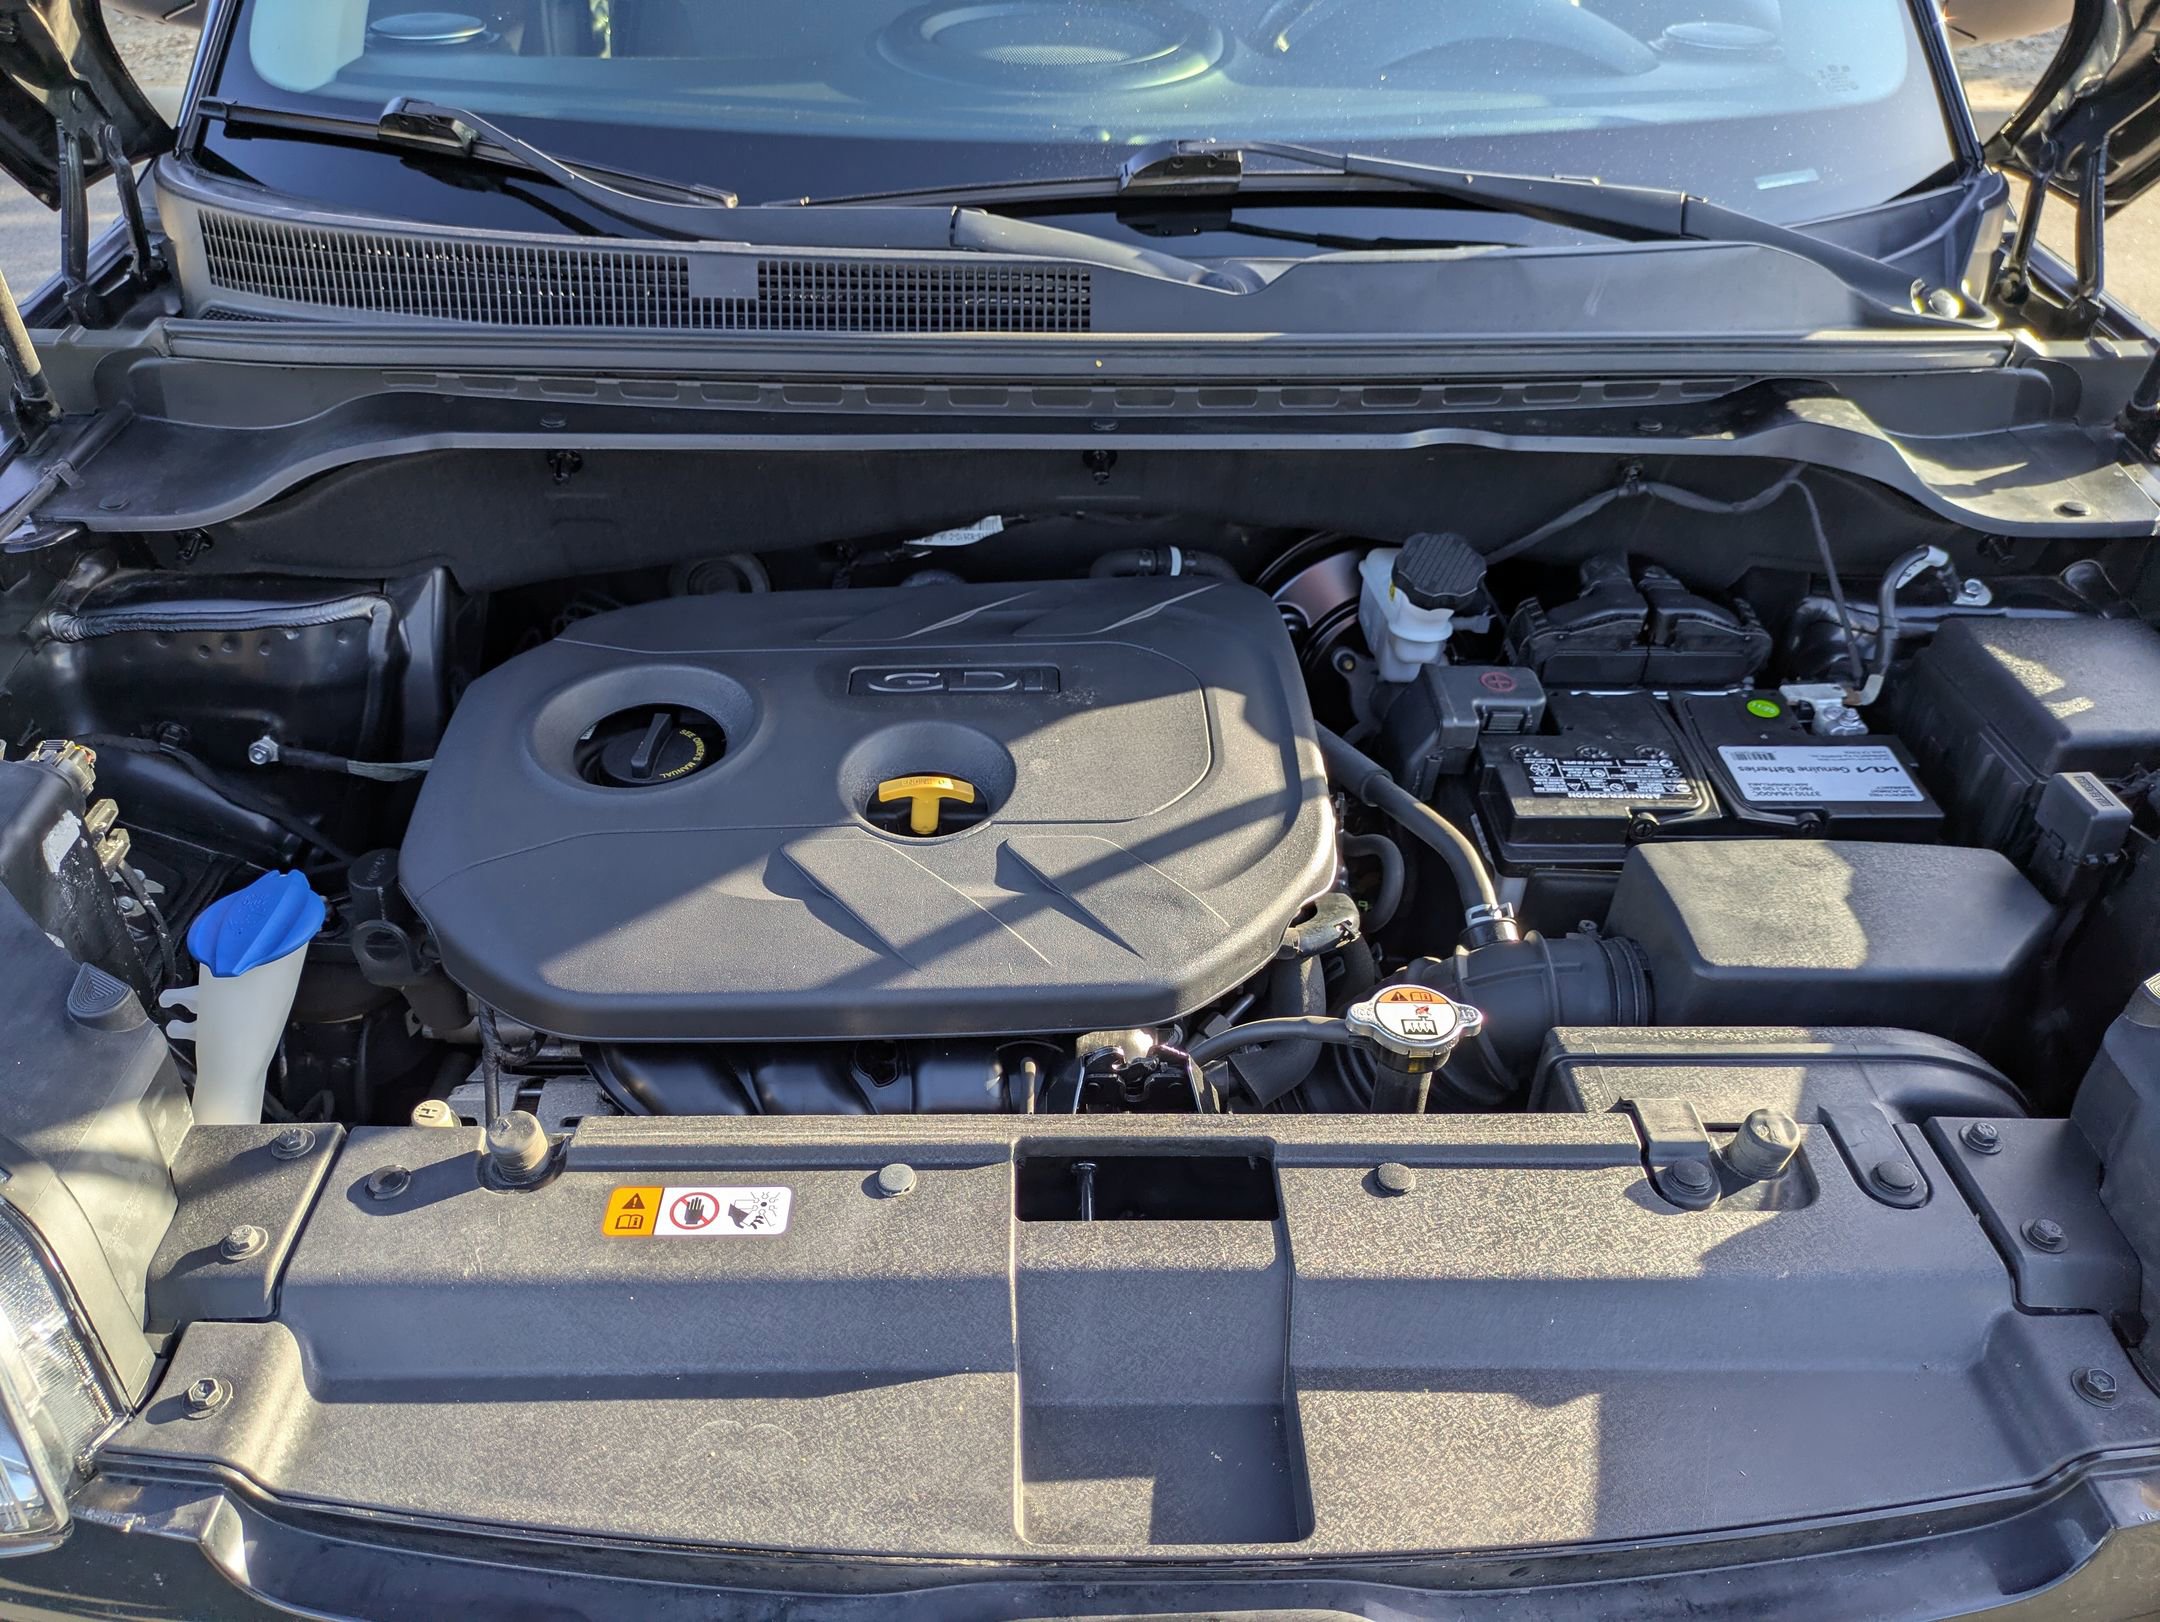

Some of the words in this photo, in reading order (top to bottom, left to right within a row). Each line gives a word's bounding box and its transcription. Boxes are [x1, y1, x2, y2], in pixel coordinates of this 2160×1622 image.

[680, 729, 696, 738] SEE
[692, 737, 705, 761] OWNER'S
[659, 761, 696, 778] MANUAL
[1738, 765, 1794, 773] Batteries
